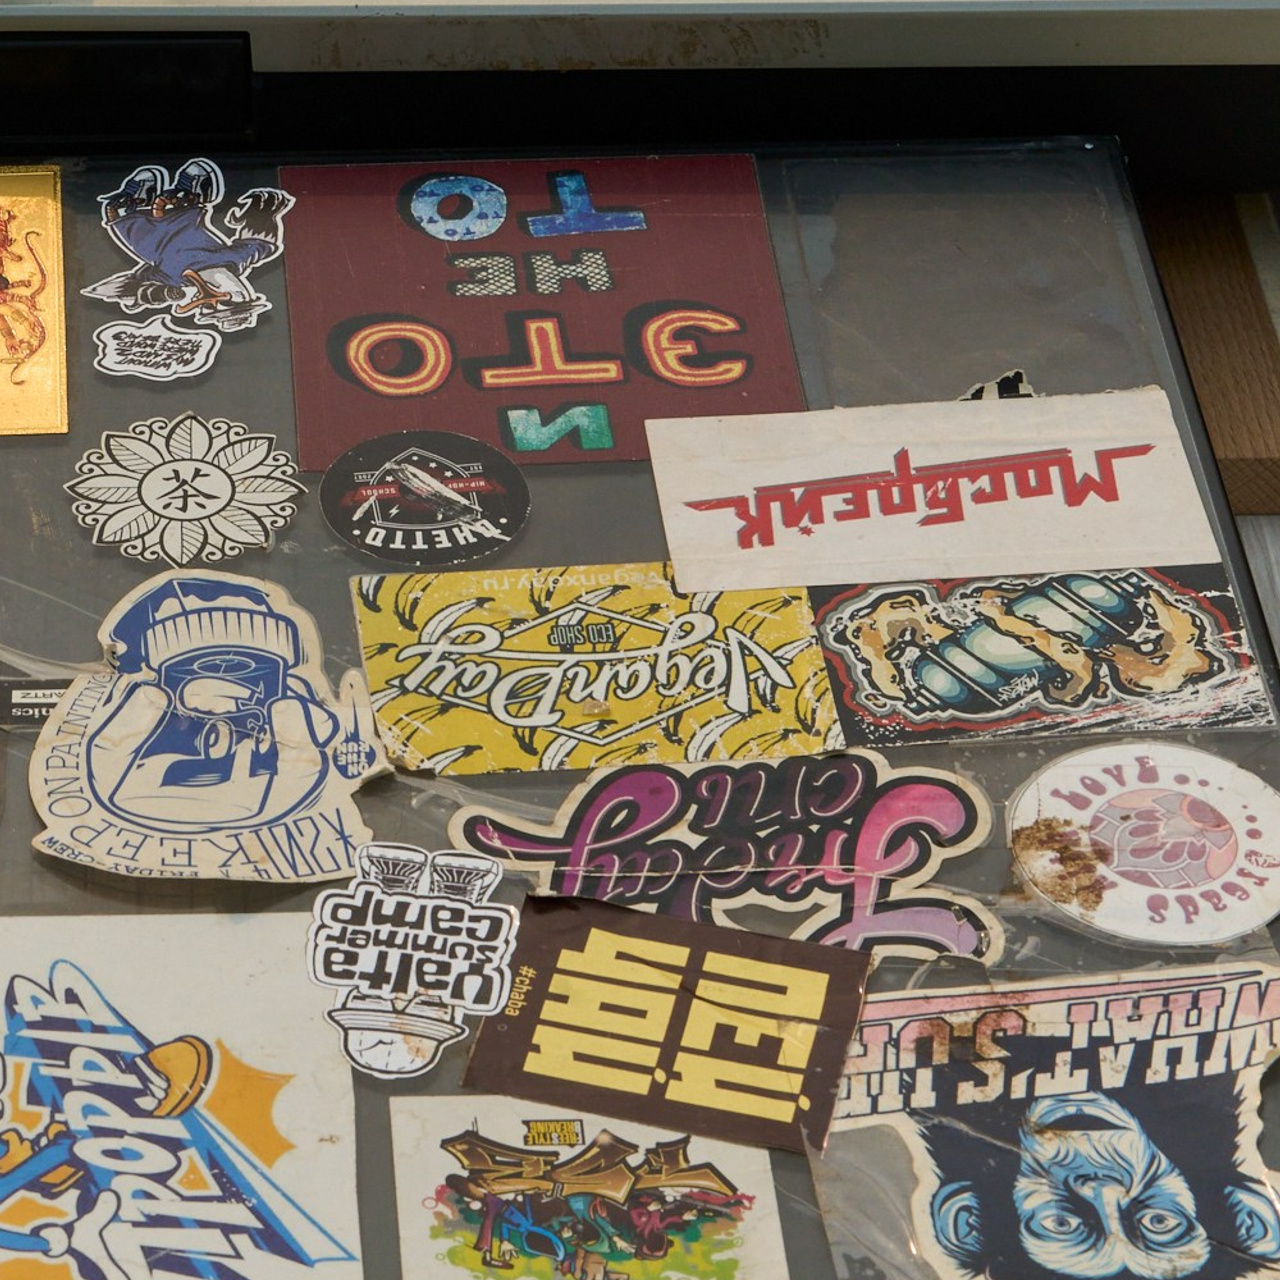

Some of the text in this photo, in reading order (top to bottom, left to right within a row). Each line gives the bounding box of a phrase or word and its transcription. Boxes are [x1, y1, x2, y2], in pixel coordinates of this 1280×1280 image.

[410, 170, 648, 242] ТО
[453, 250, 613, 297] НЕ
[113, 357, 170, 370] WITHOUT
[346, 310, 747, 397] ЭТО
[507, 405, 614, 451] И
[361, 487, 397, 497] SCHOOL
[547, 621, 617, 646] ECO SHOP
[335, 740, 370, 754] RUN
[336, 752, 368, 765] THE
[45, 672, 252, 868] KEEP ON PAINTING
[346, 761, 370, 777] ON
[330, 890, 504, 942] camp
[324, 925, 499, 965] summer
[504, 964, 538, 1017] #chaba
[523, 927, 691, 1096] ЧАЙ
[665, 951, 831, 1123] ПЕЙ
[525, 1131, 582, 1146] FREESTYLE
[529, 1120, 580, 1133] BREAKING
